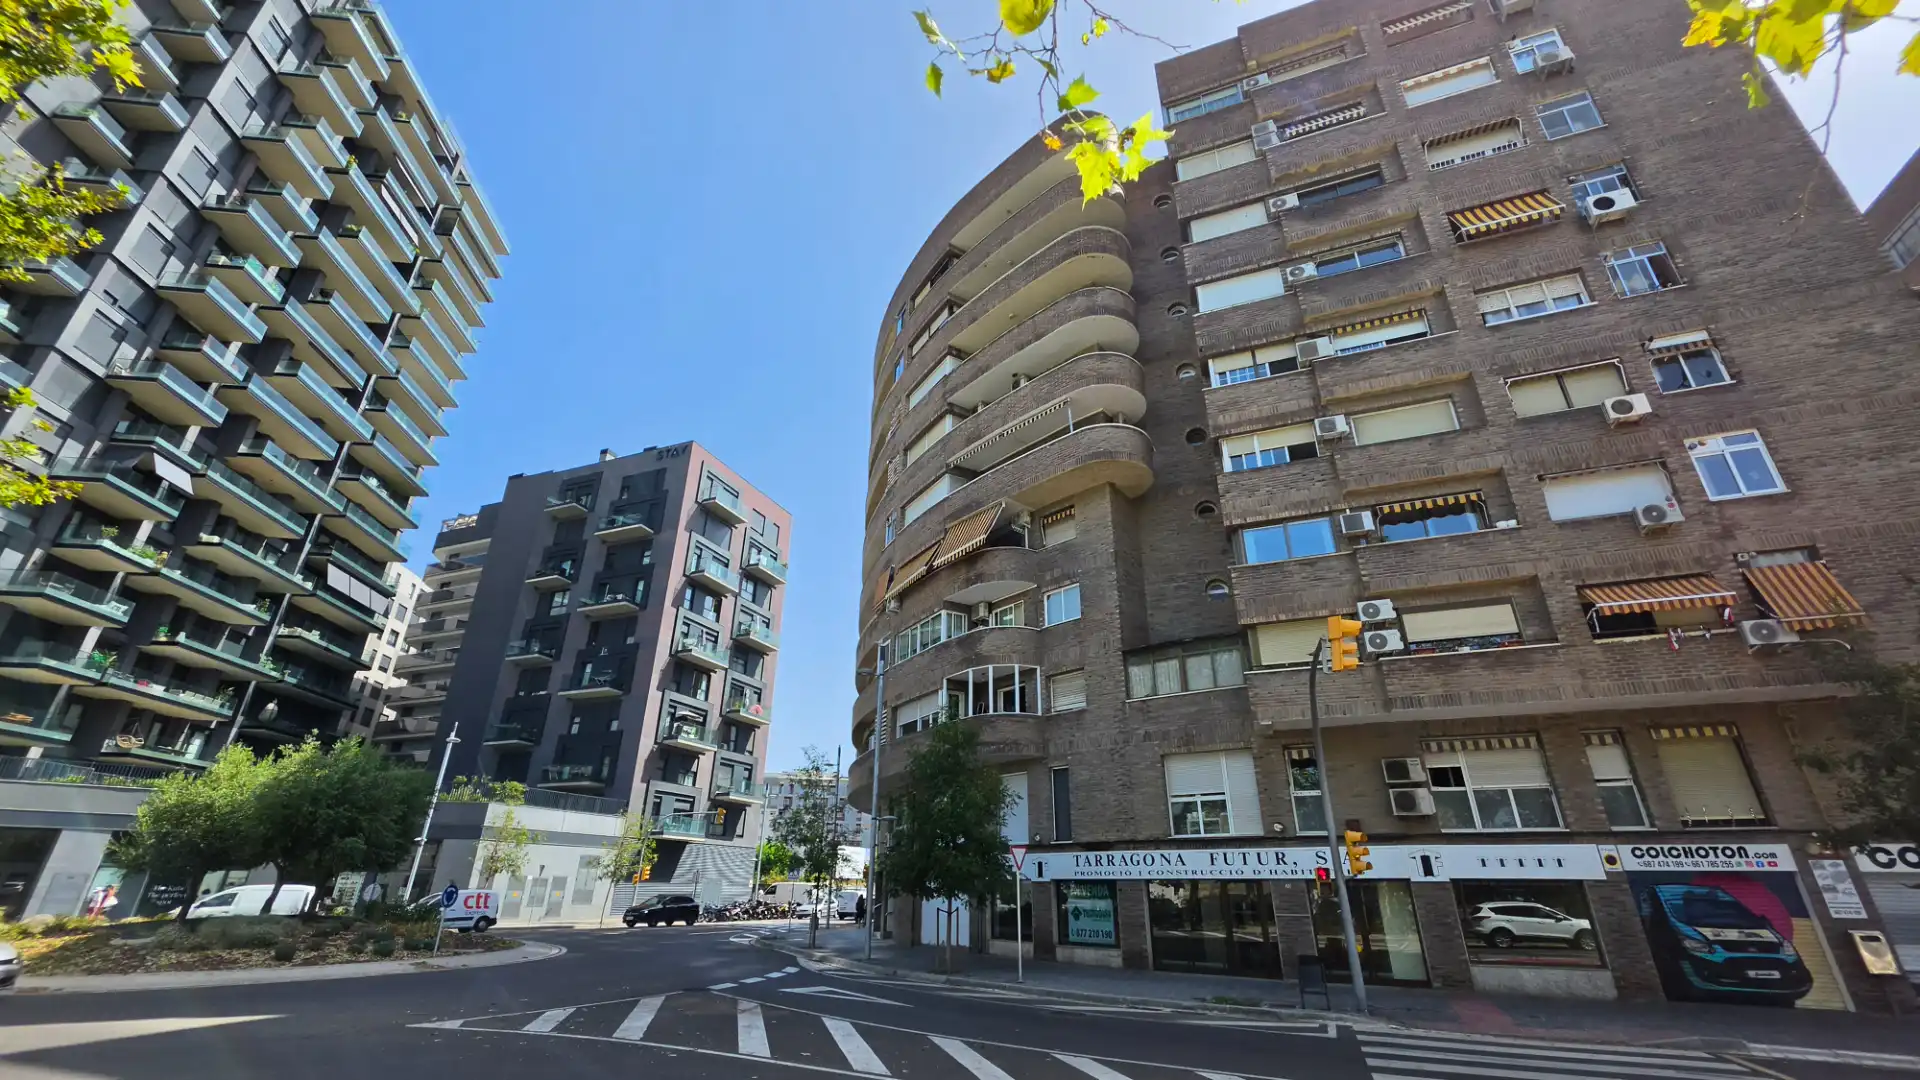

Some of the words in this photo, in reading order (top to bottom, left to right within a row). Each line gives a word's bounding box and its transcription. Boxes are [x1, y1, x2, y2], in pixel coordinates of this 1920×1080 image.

[1073, 852, 1187, 868] TARRAGONA
[1209, 851, 1298, 868] FUTUR,
[1643, 860, 1656, 868] 687
[1657, 860, 1671, 868] 474
[1705, 860, 1720, 868] 785
[1720, 860, 1735, 868] 255
[1074, 868, 1132, 877] PROMOCIÓ
[1147, 868, 1245, 877] CONSTRUCCIÓ
[463, 892, 491, 909] ctt
